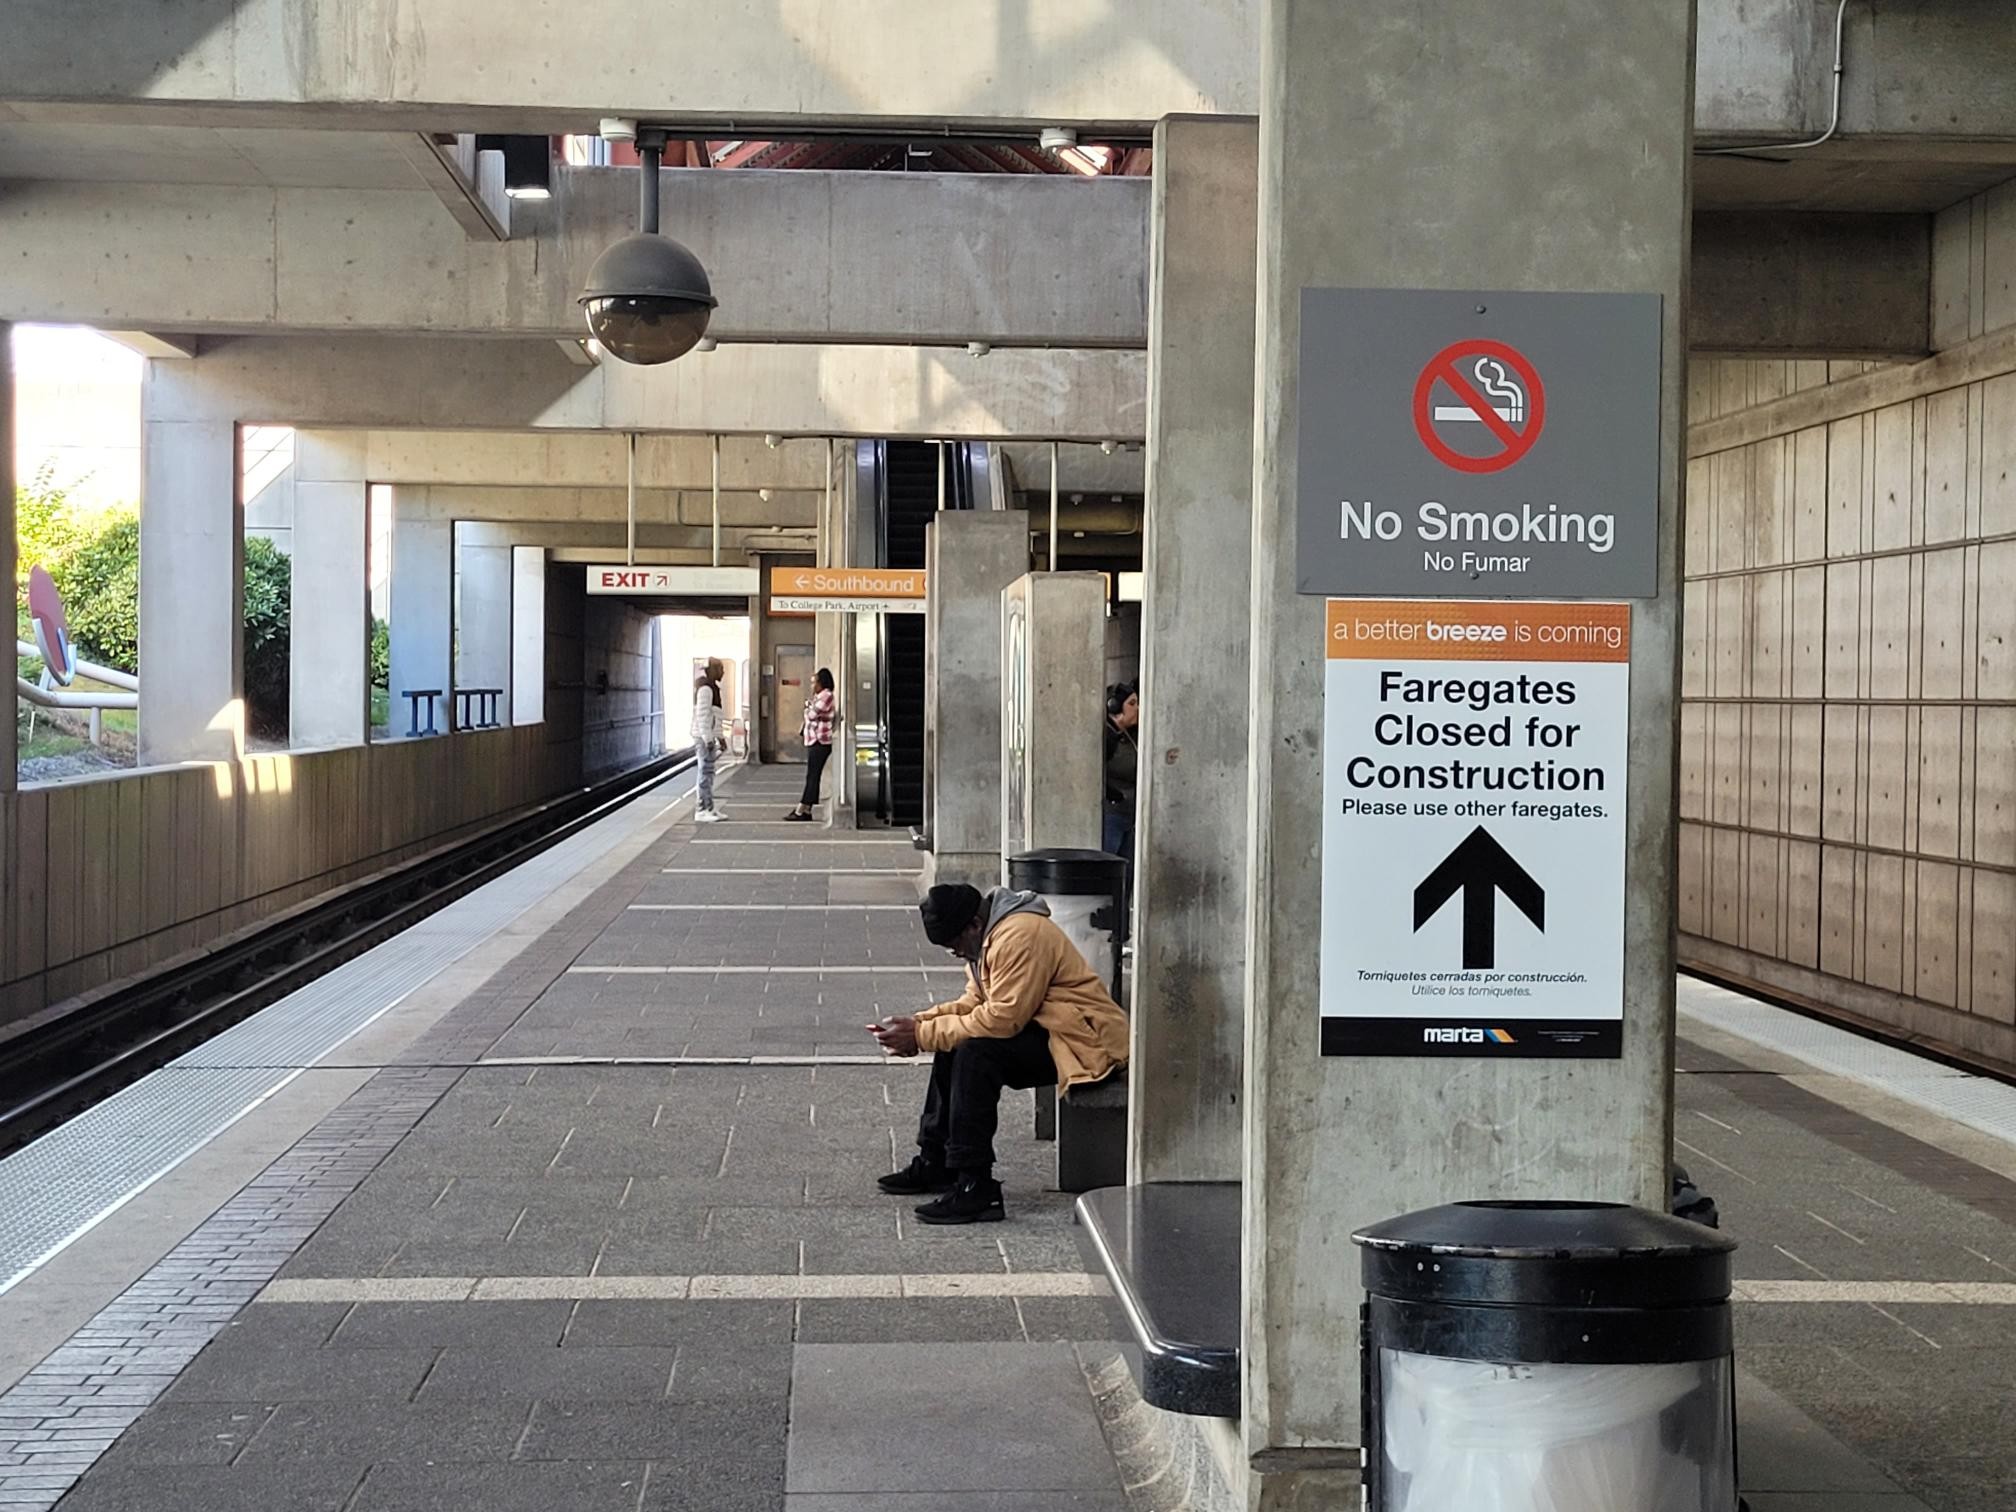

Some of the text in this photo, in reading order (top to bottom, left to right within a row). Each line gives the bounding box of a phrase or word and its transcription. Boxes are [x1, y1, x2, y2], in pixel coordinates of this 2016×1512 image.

[1340, 501, 1616, 553] No Smoking
[1424, 551, 1531, 572] No Fumar
[601, 572, 650, 587] EXIT
[813, 574, 915, 592] Southbound
[777, 600, 790, 609] To
[848, 602, 879, 612] Airport
[1333, 618, 1622, 648] a better breeze is coming
[1380, 671, 1576, 711] Faregates
[1374, 713, 1581, 748] Closed for
[1346, 756, 1605, 791] Construction
[1342, 798, 1609, 821] Please use other faregates.
[1357, 970, 1588, 984] Torniquetes cerradas por construcción.
[1411, 985, 1532, 998] Utilice los torniquetes.
[1423, 1027, 1484, 1043] marta
